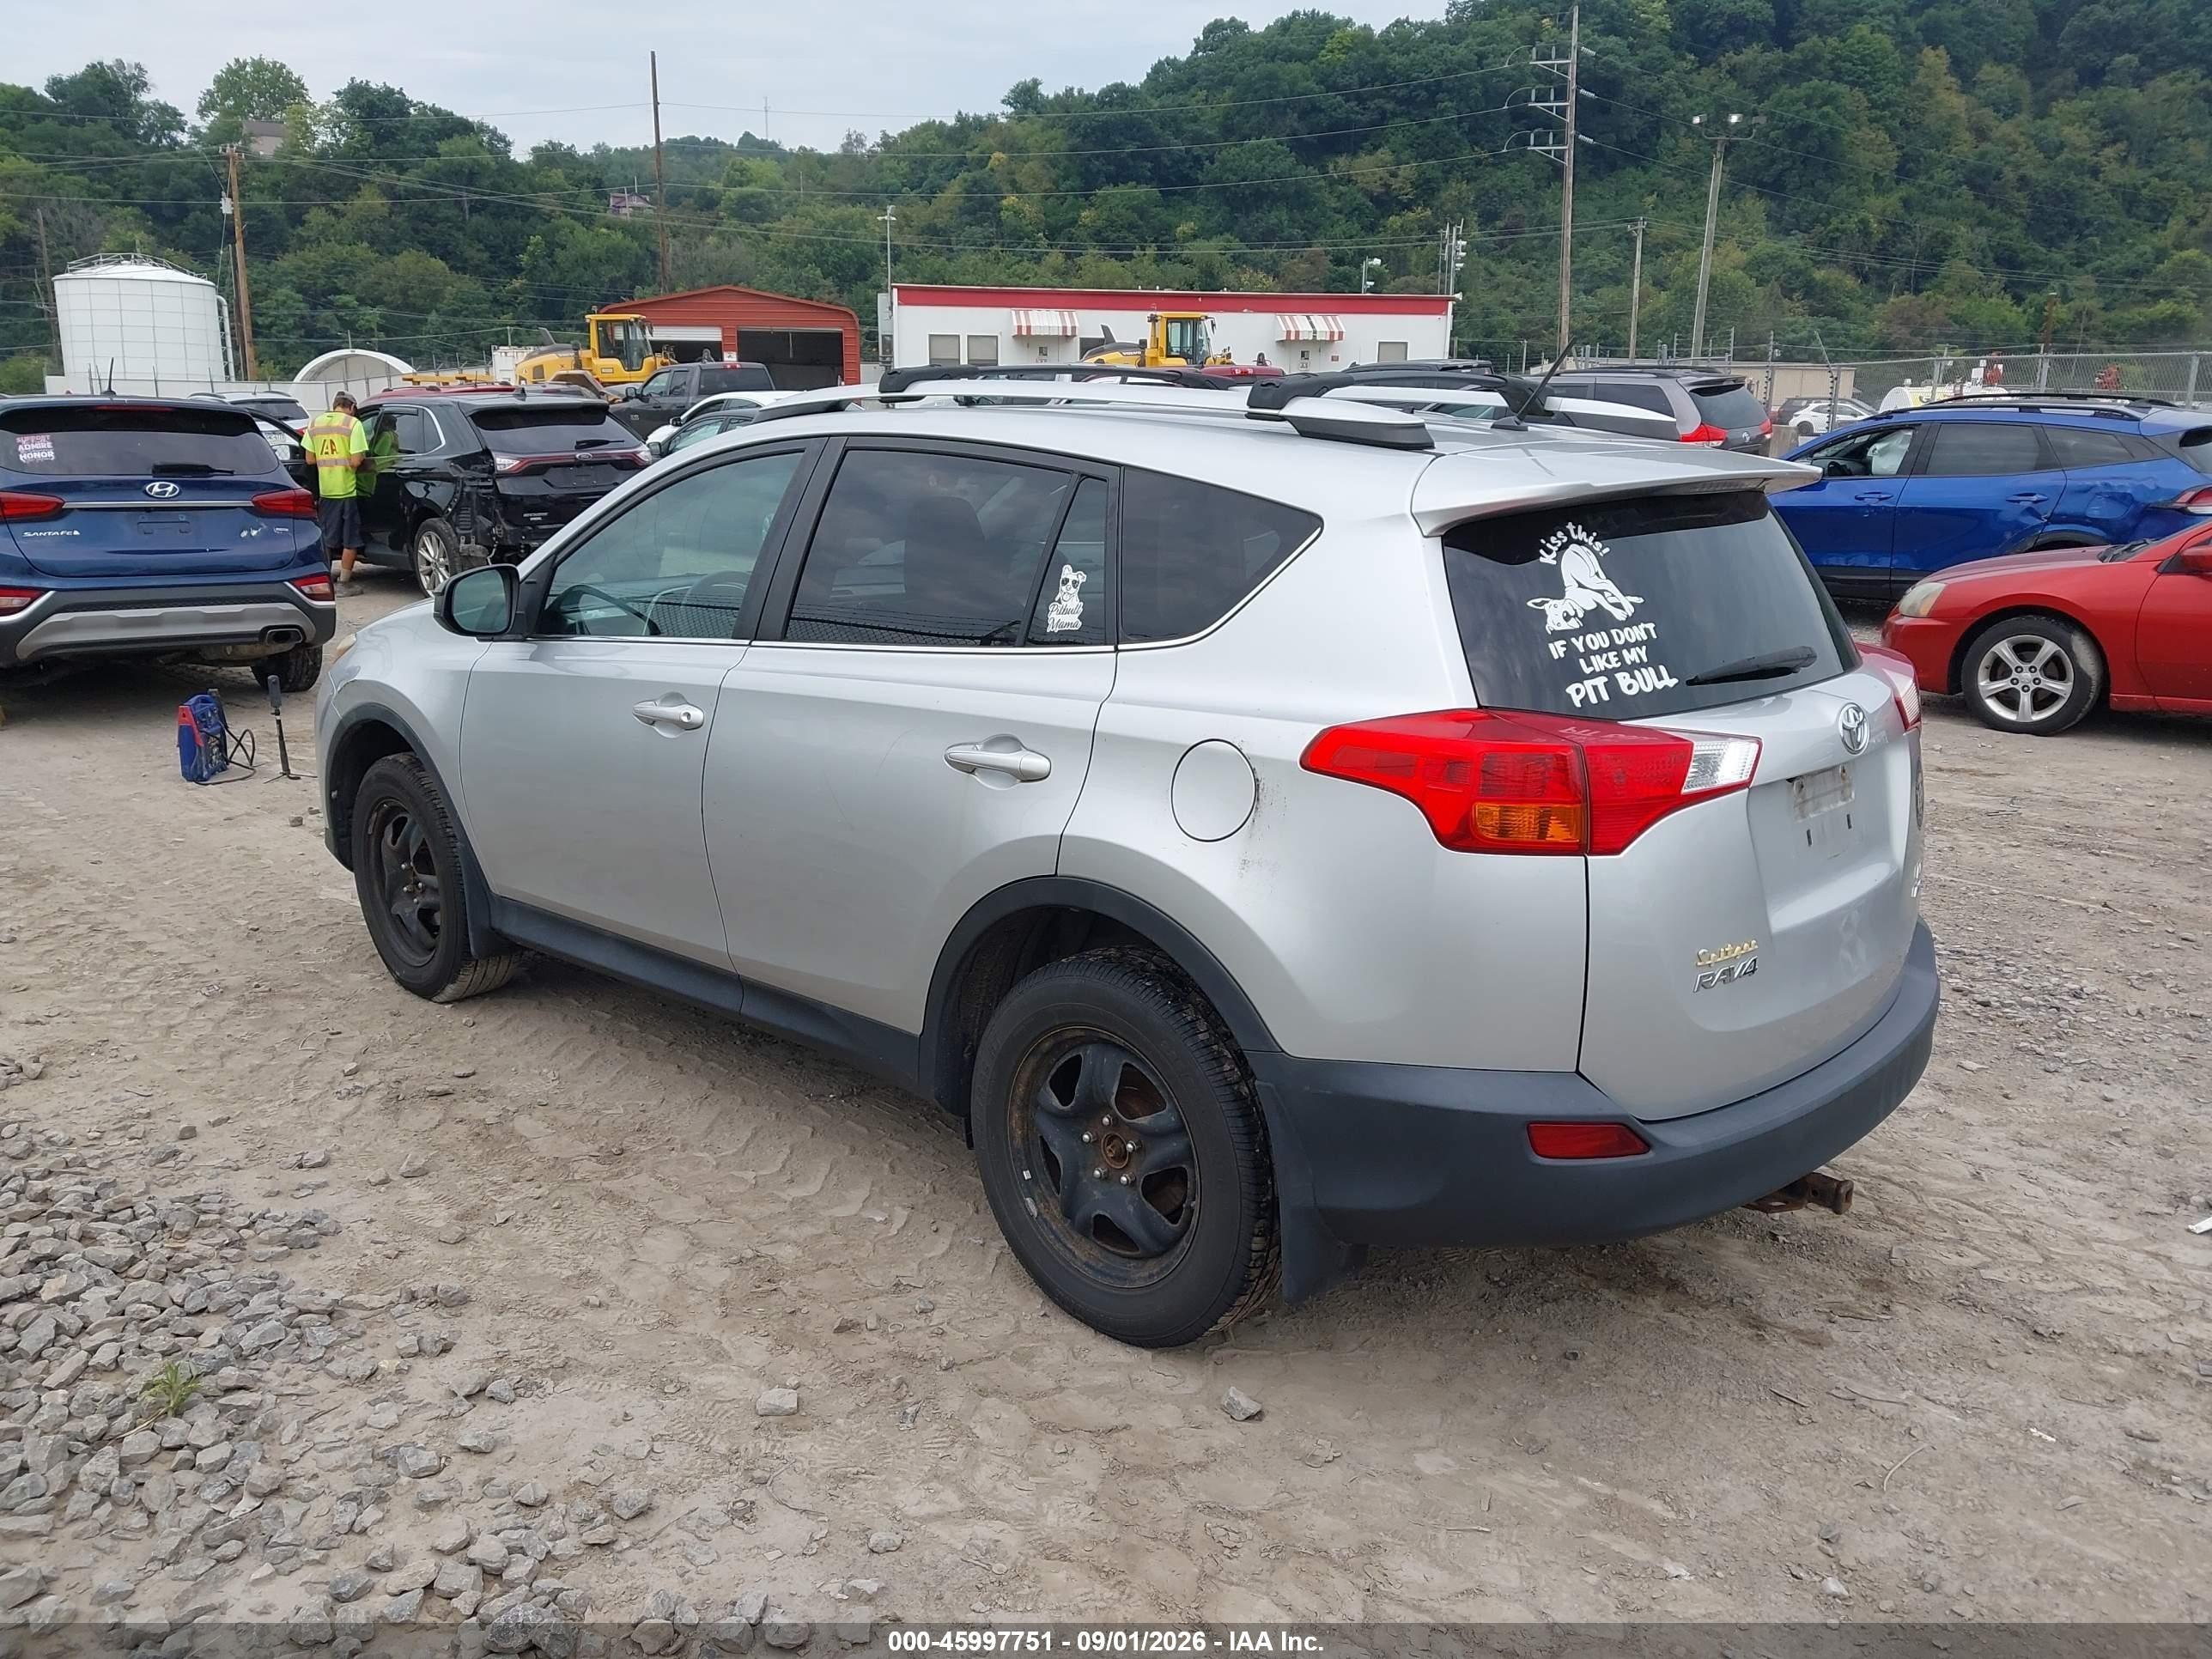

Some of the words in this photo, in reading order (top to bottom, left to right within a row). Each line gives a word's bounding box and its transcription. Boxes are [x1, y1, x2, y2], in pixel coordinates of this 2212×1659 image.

[18, 442, 53, 452] ADMIRE
[19, 451, 56, 463] HONOR
[1539, 531, 1568, 565] Kiss
[1565, 521, 1610, 557] this!
[1048, 602, 1083, 616] Pitbull
[1048, 617, 1080, 631] Mama
[1547, 640, 1567, 660] IF
[1571, 630, 1610, 653] YOU
[1610, 623, 1657, 645] DON'T
[1578, 651, 1622, 674] LIKE
[1621, 645, 1648, 665] MY
[1565, 675, 1611, 708] PIT
[1613, 665, 1680, 696] BULL
[1692, 955, 1759, 994] RAV4
